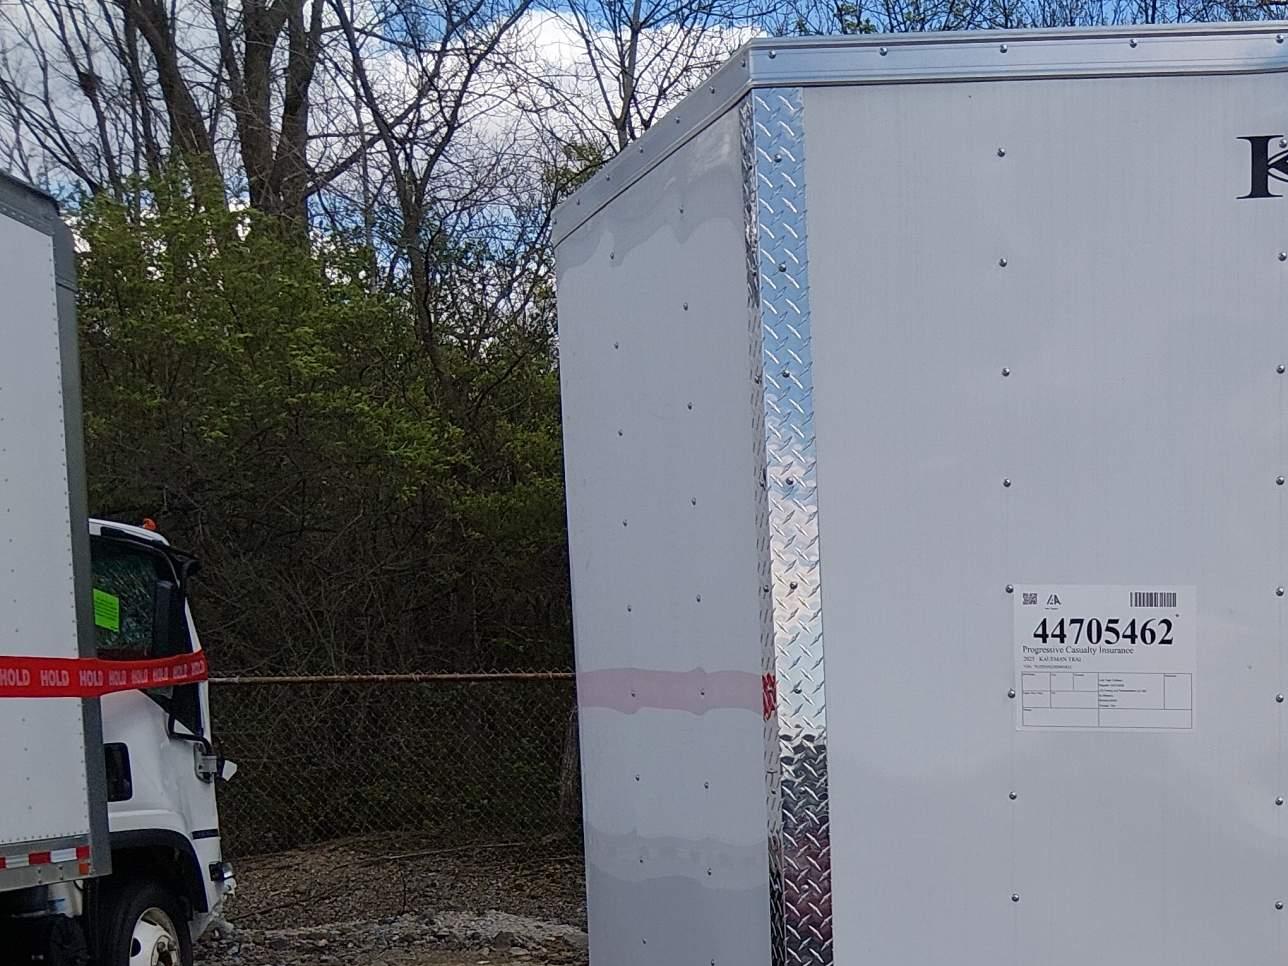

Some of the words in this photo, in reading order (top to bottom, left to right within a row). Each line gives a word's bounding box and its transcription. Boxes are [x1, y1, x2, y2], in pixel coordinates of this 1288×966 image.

[1033, 617, 1174, 645] 44705462
[1022, 645, 1064, 656] Progressive
[1065, 645, 1097, 655] Casualty
[1099, 646, 1135, 654] Insurance
[0, 668, 31, 687] HOLD
[40, 669, 70, 687] HOLD
[79, 669, 104, 687] HOLD
[108, 670, 127, 686] HOLD
